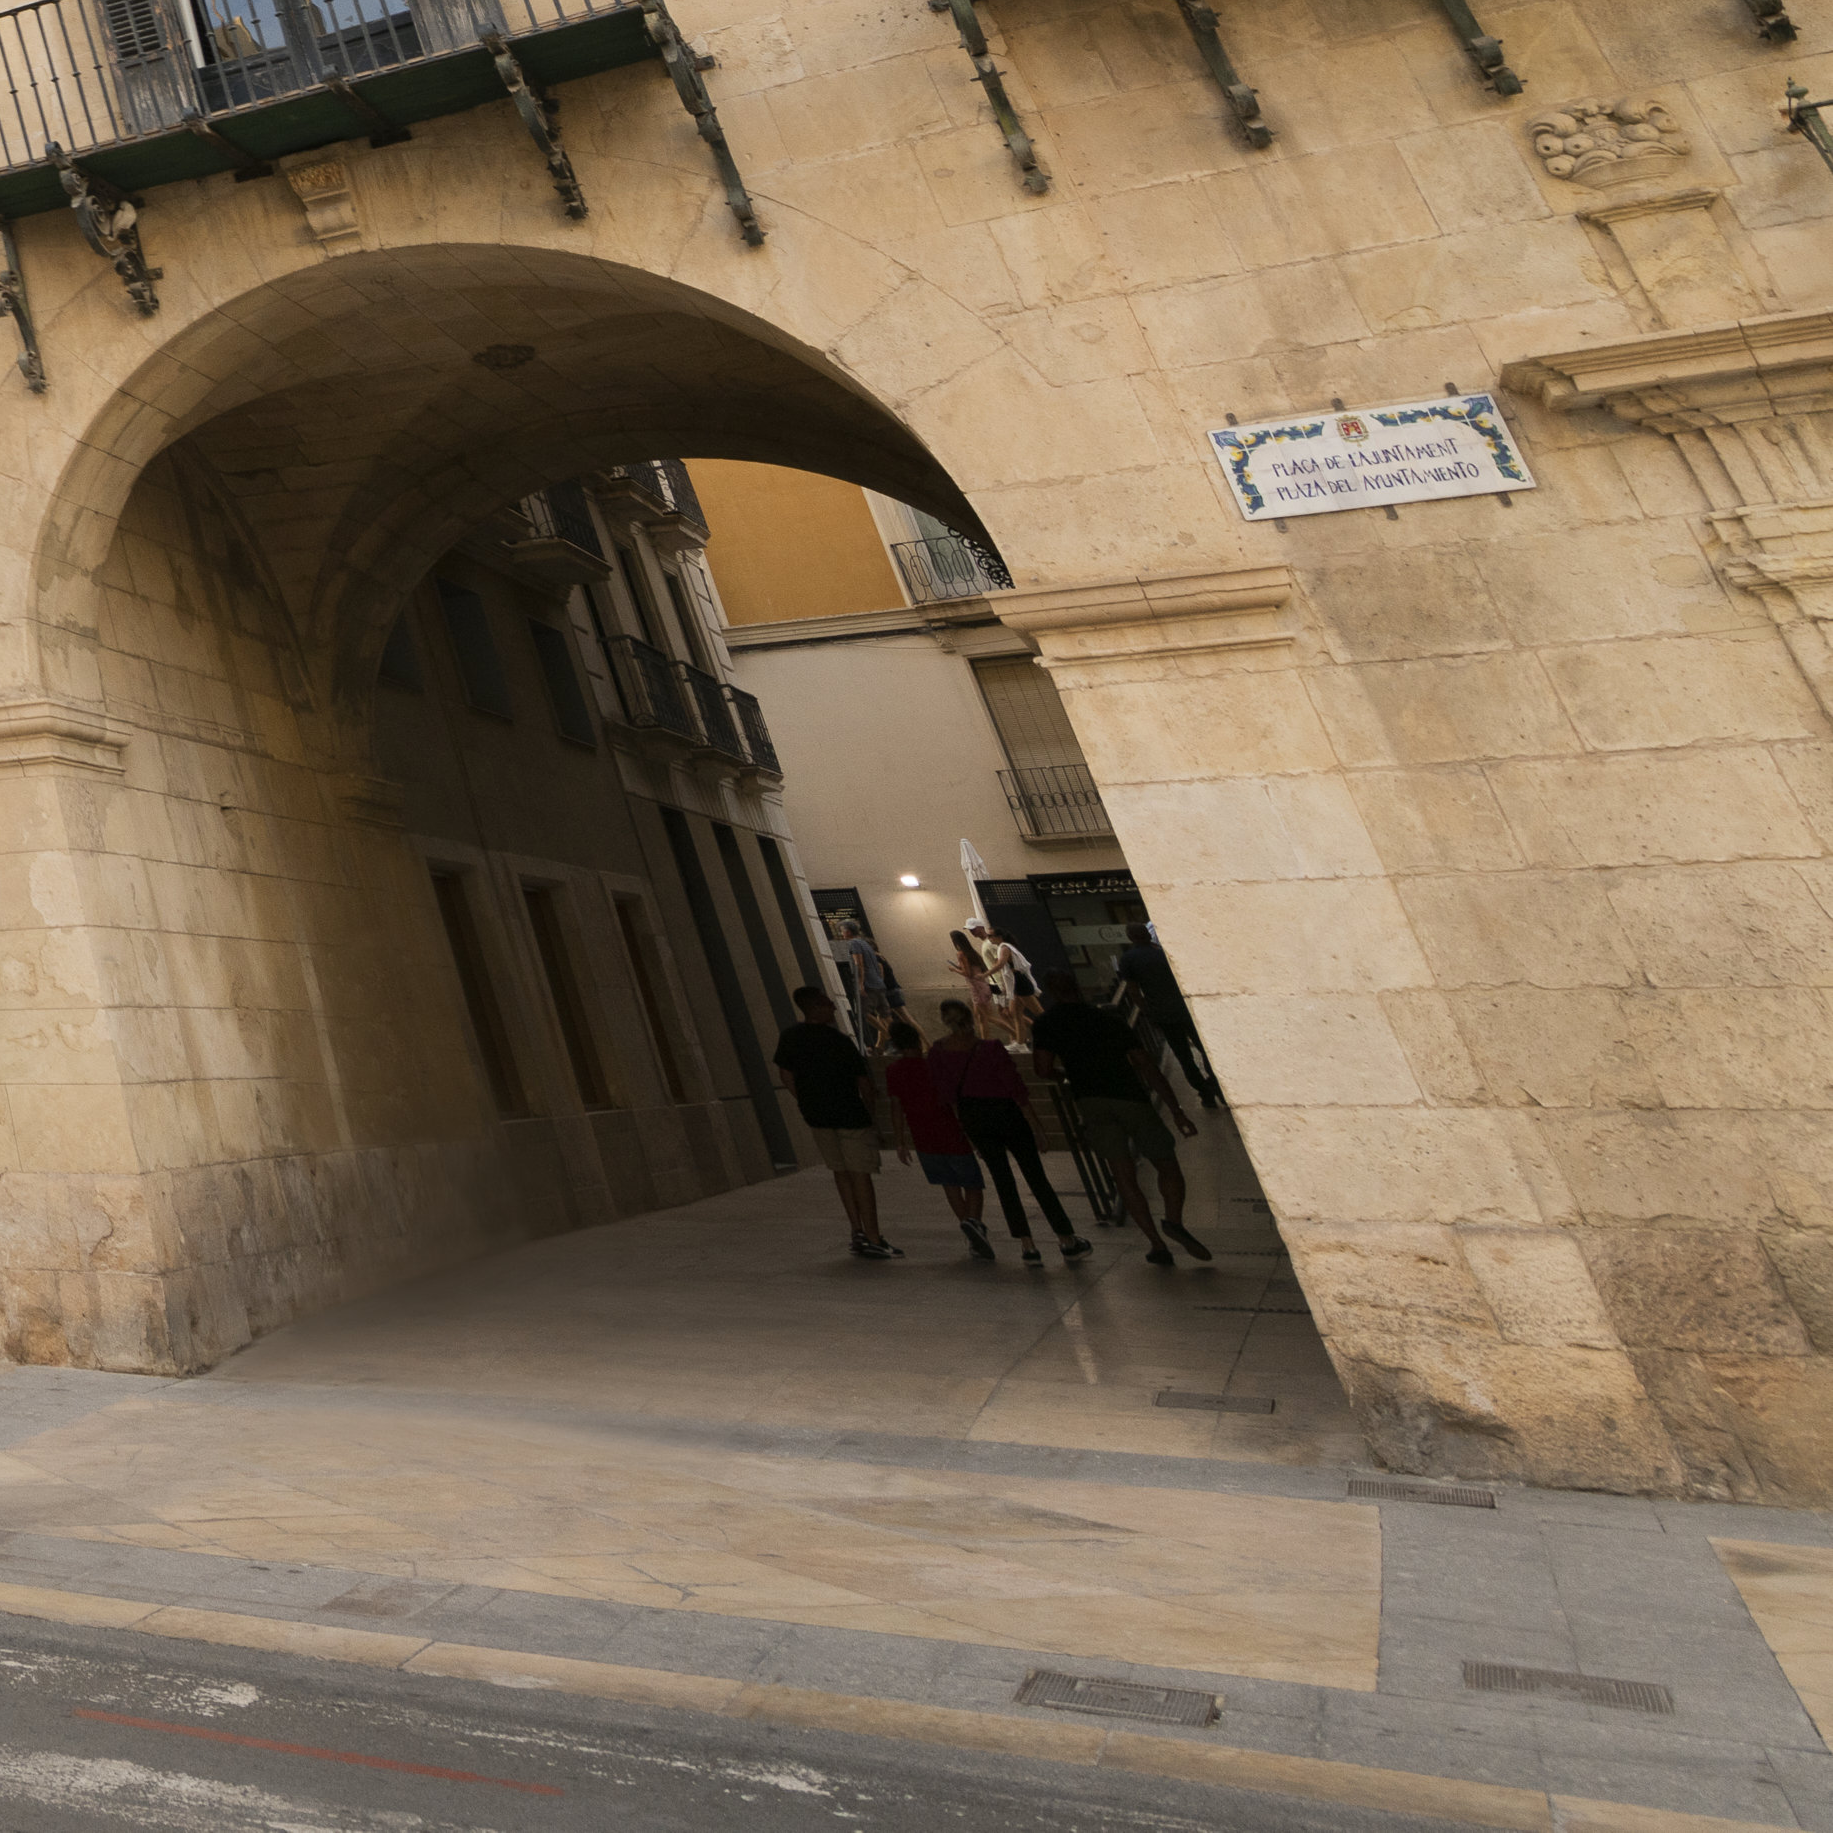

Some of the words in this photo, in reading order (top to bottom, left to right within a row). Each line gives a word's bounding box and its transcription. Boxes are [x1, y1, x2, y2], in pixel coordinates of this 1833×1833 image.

[1324, 454, 1346, 470] DE
[1276, 479, 1327, 501] PLAZA
[1327, 478, 1358, 495] DEL
[1363, 461, 1480, 491] AYUNTAMIENTO
